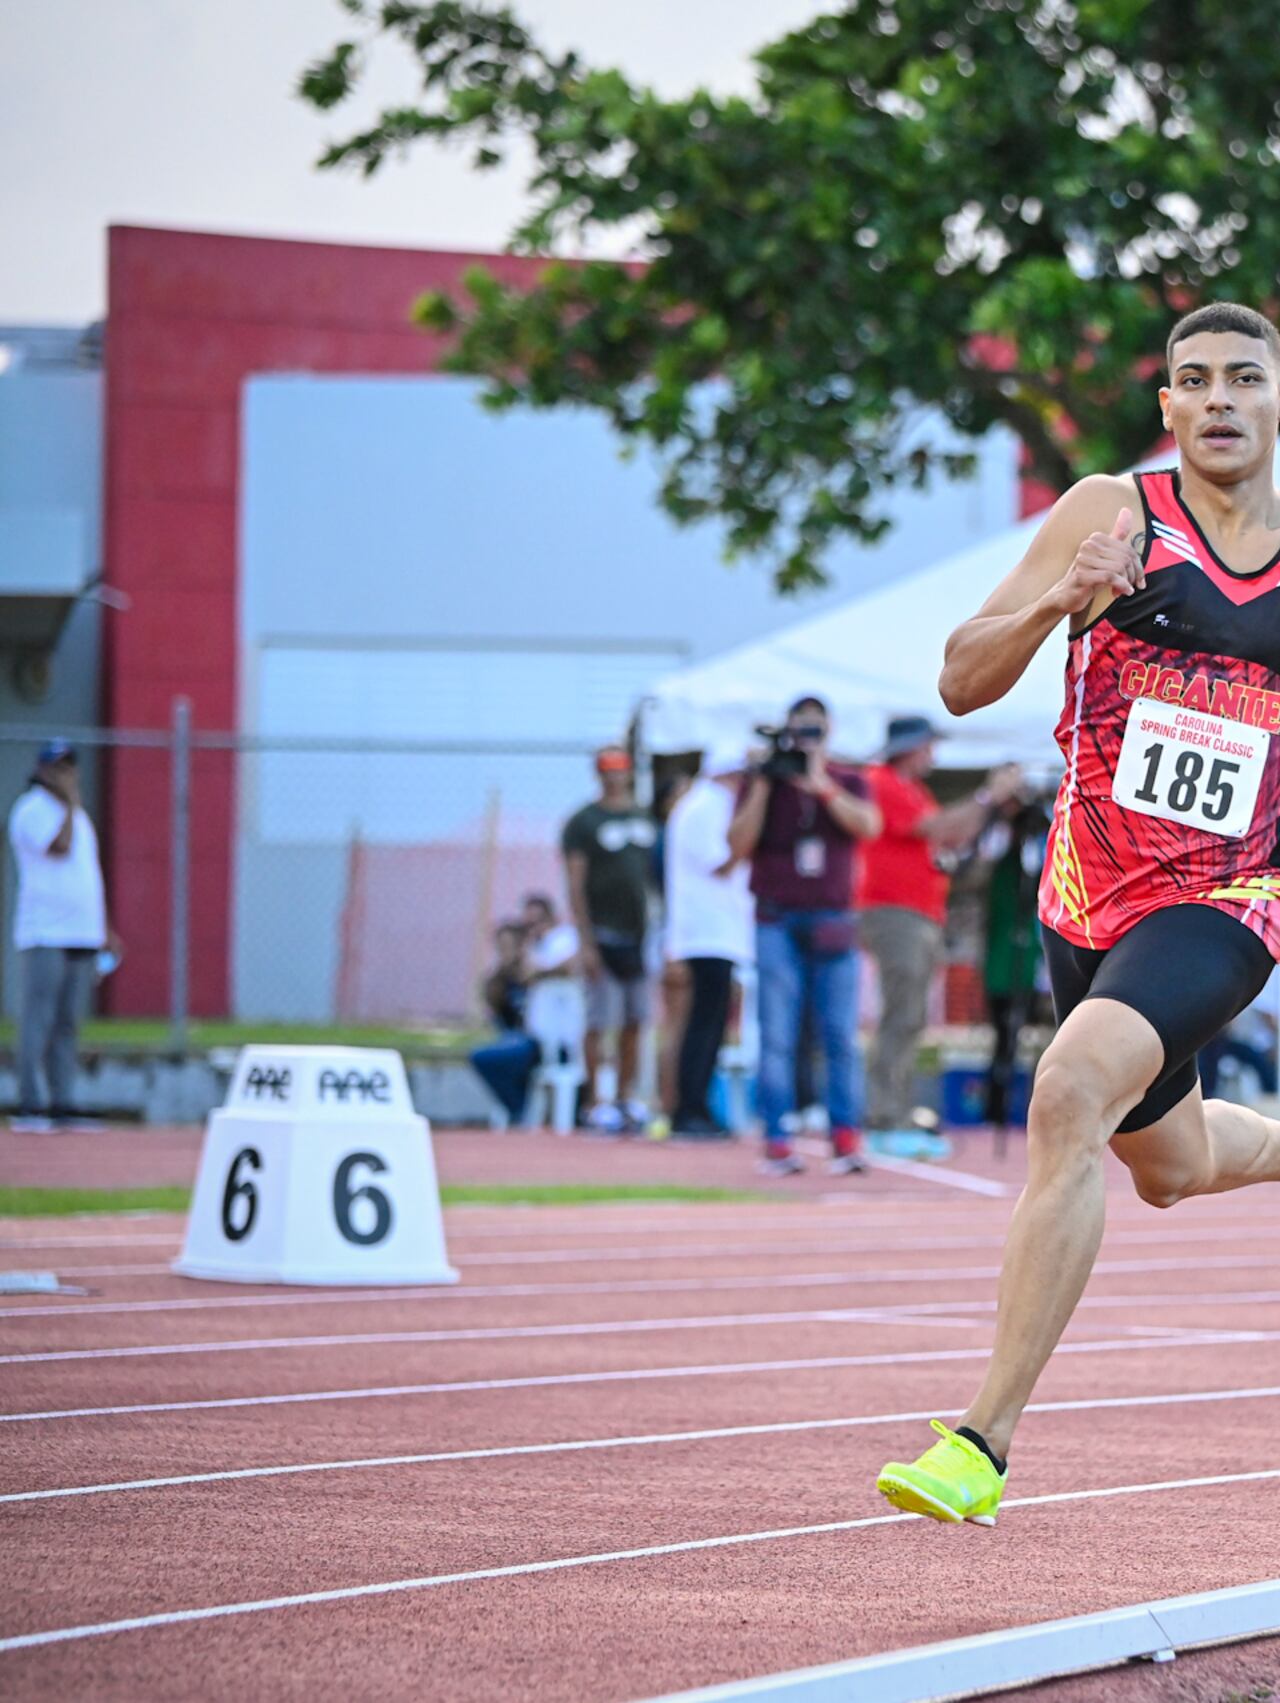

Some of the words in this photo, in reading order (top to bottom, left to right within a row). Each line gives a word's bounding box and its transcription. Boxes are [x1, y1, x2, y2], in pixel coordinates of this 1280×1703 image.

[1140, 718, 1178, 740] SPRING
[1179, 728, 1213, 749] BREAK
[1212, 737, 1255, 759] CLASSIC
[1174, 712, 1224, 737] CAROLINA
[1134, 743, 1241, 821] 185
[221, 1146, 263, 1242] 6
[333, 1152, 392, 1246] 6
